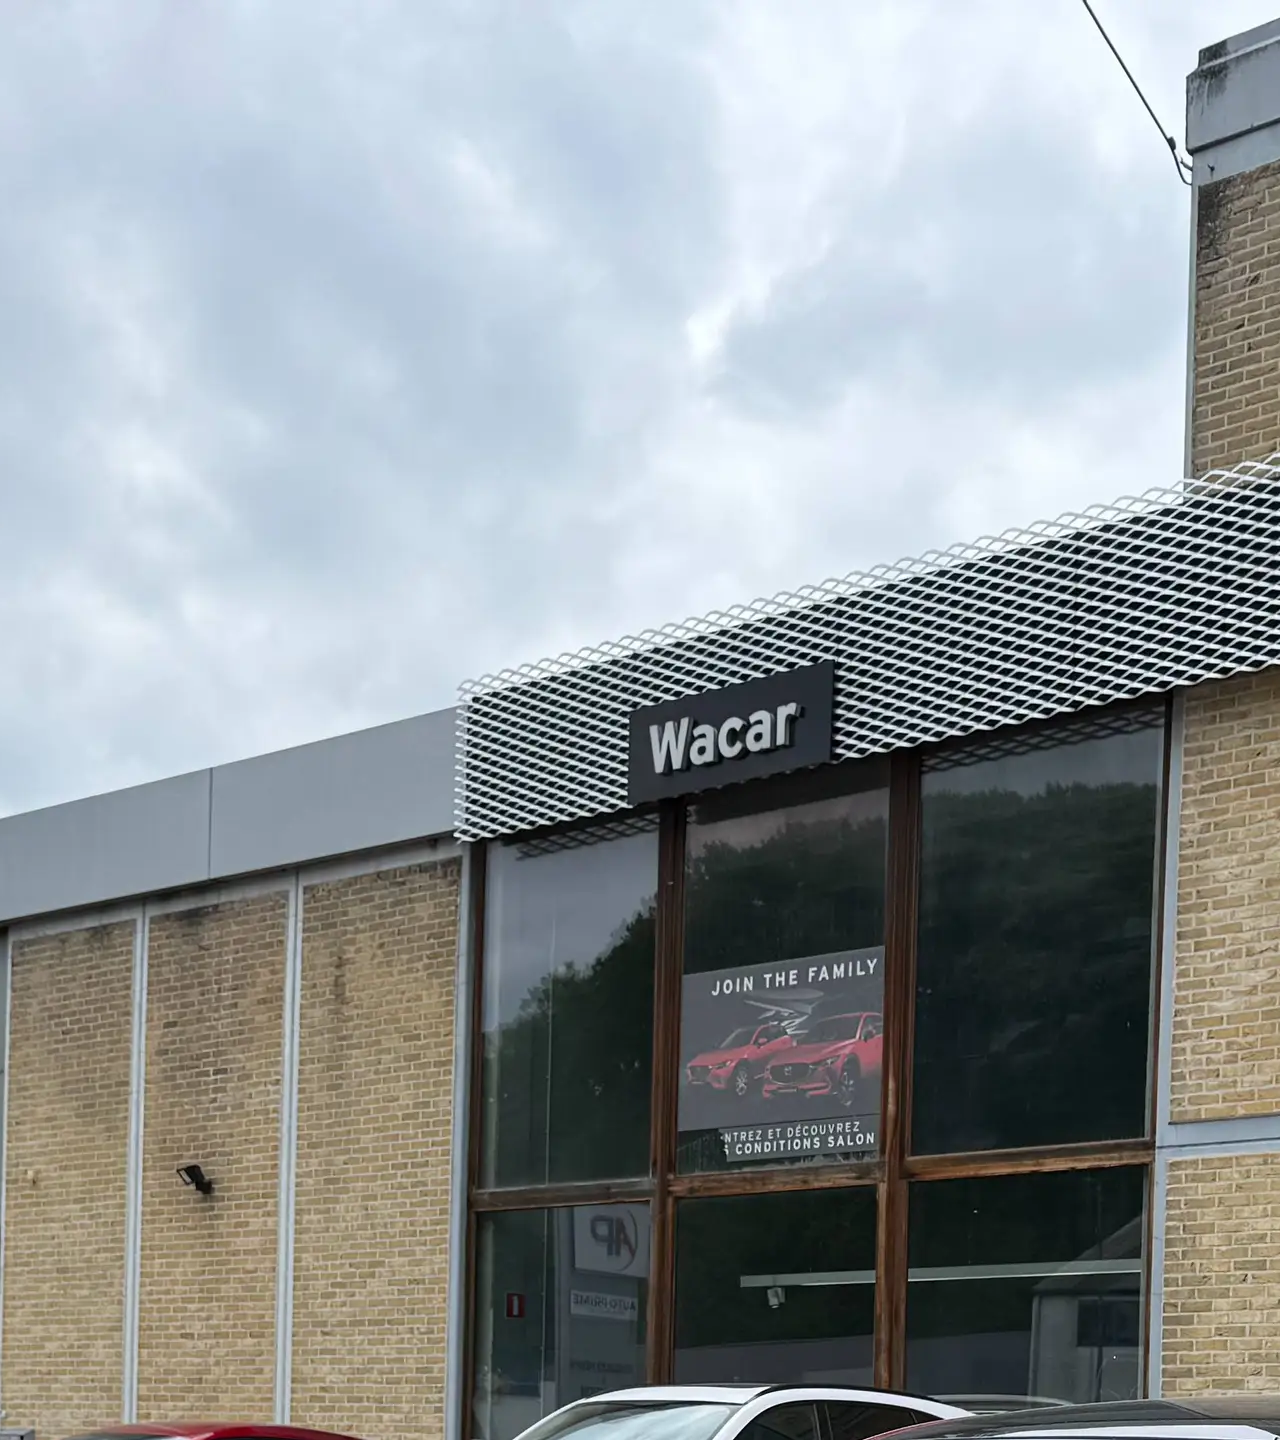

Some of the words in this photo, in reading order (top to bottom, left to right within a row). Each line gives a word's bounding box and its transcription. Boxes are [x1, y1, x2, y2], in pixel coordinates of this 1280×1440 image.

[649, 702, 799, 775] Wacar
[711, 976, 754, 996] JOIN
[763, 969, 798, 988] THE
[808, 958, 878, 983] FAMILY
[721, 1129, 762, 1144] NTREZ
[768, 1128, 782, 1139] ET
[787, 1122, 860, 1138] DÉCOUVREZ
[735, 1137, 821, 1155] CONDITIONS
[827, 1132, 875, 1148] SALON
